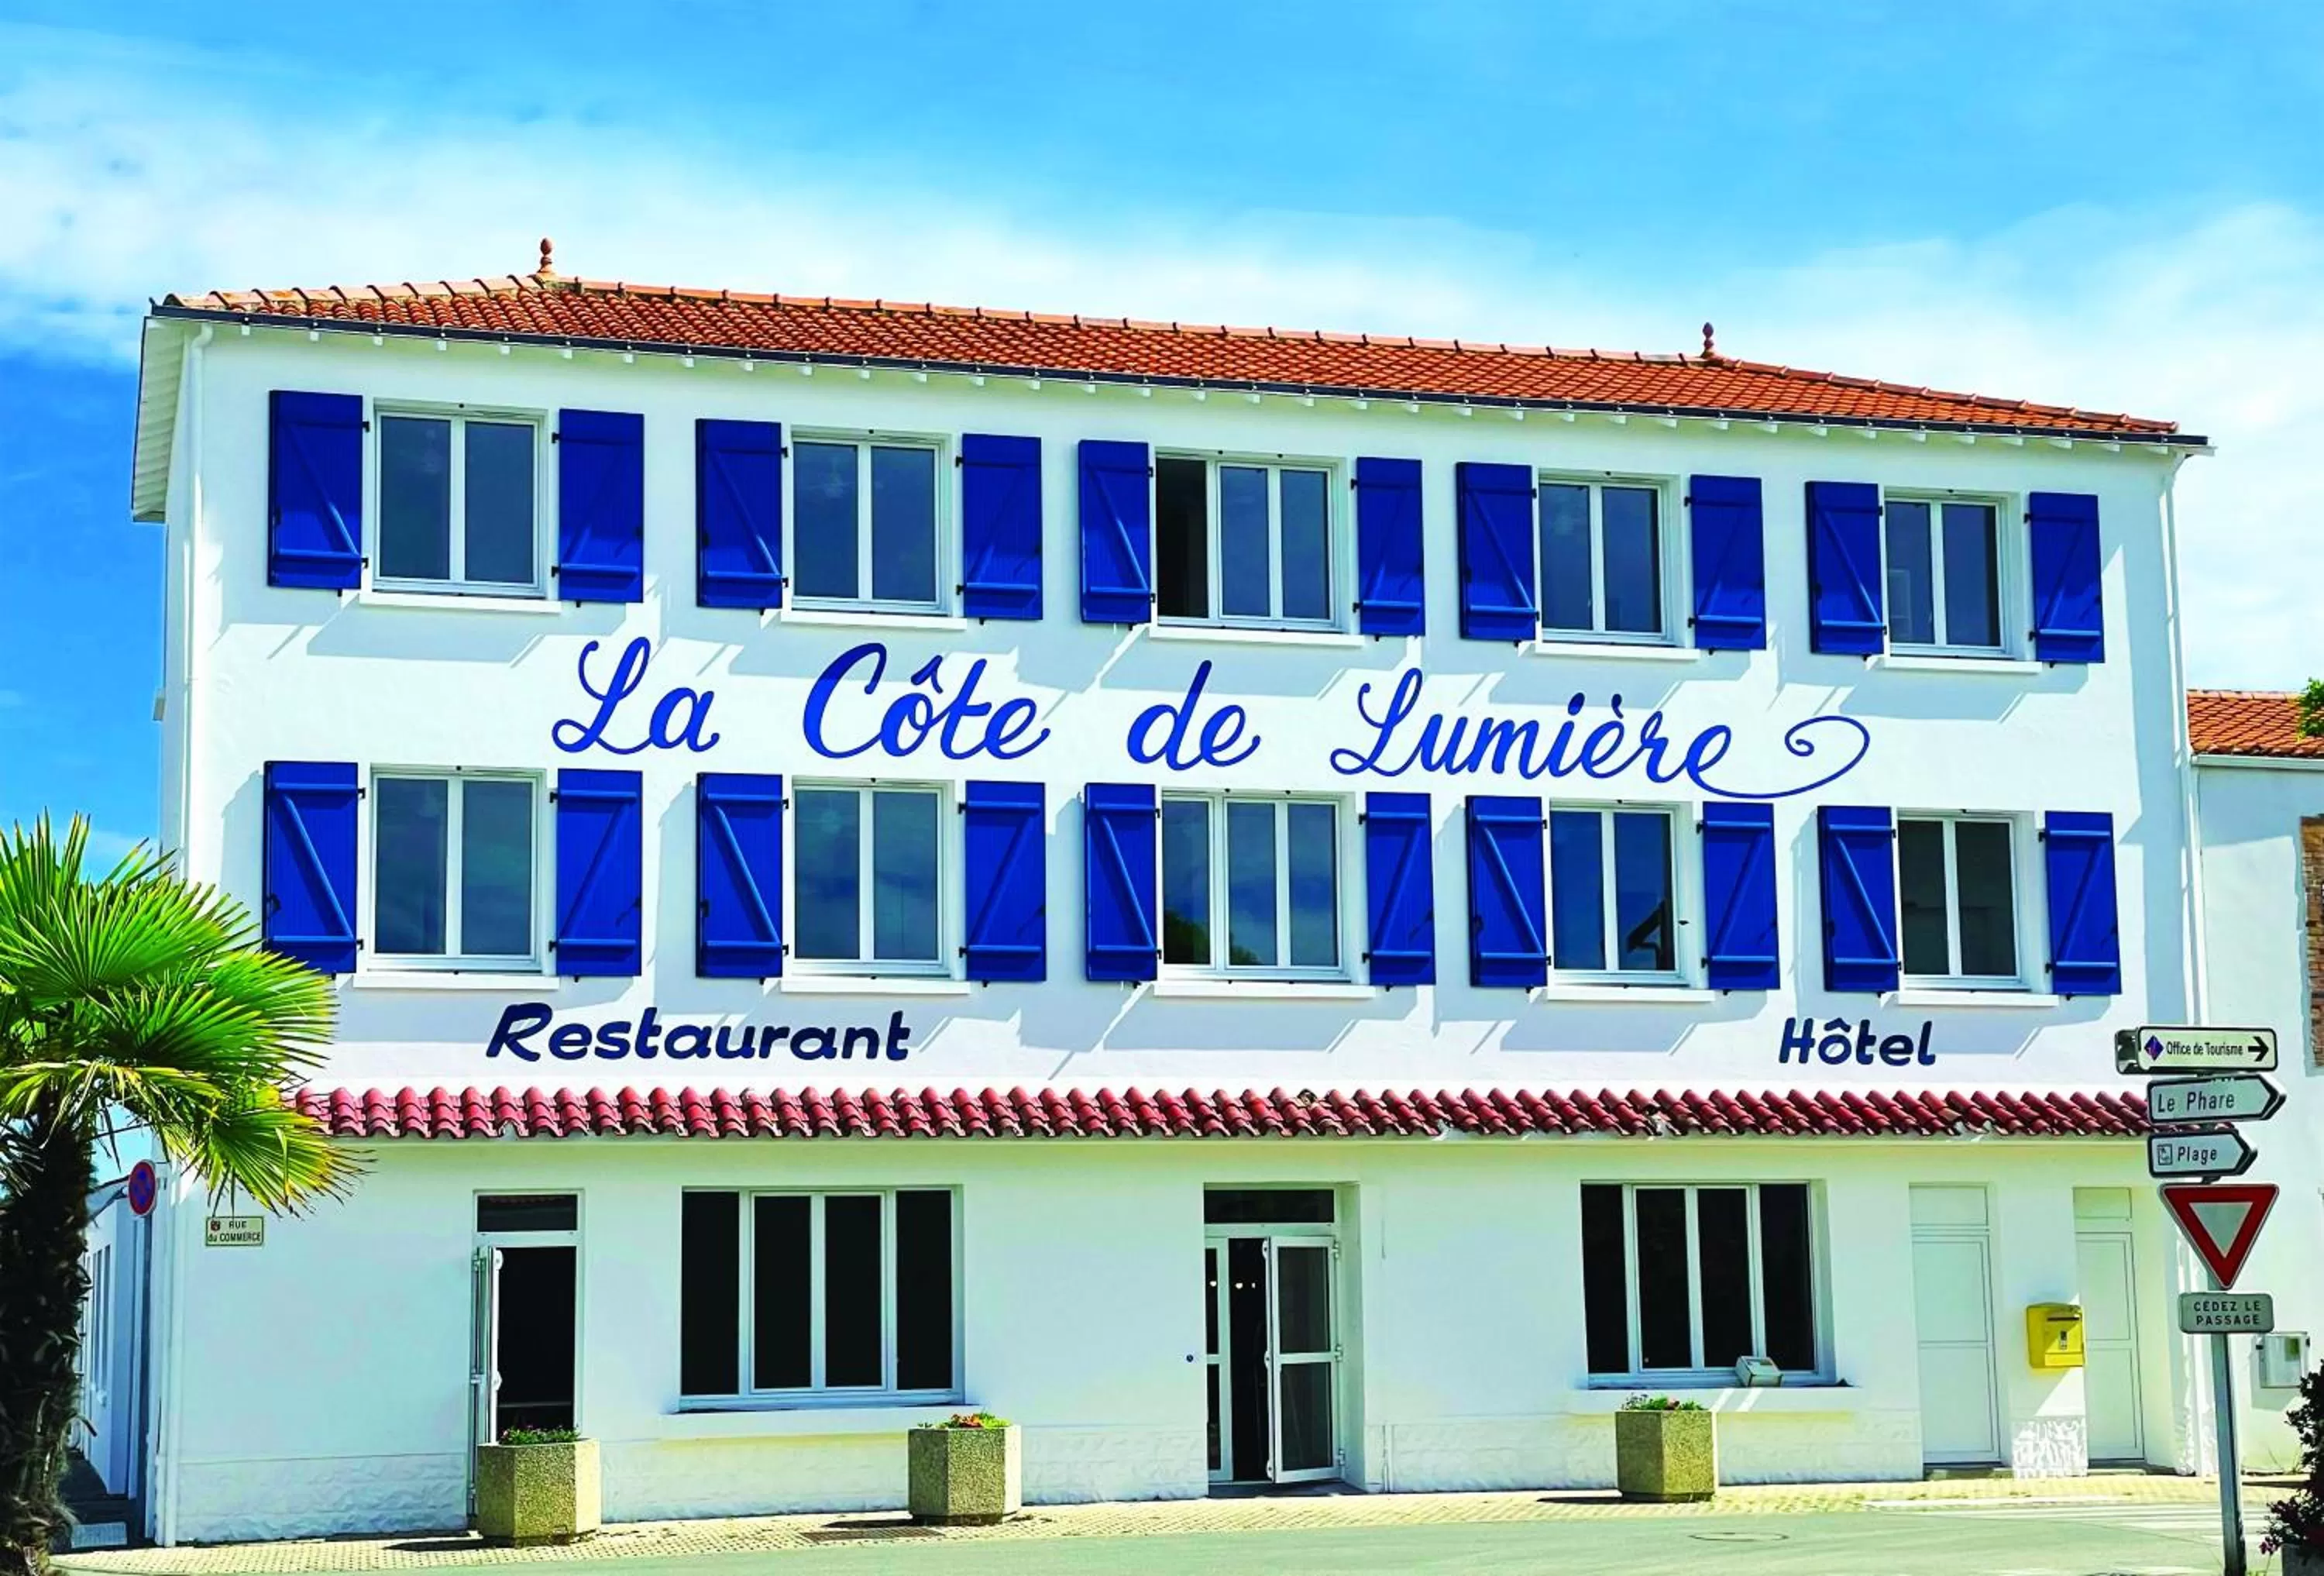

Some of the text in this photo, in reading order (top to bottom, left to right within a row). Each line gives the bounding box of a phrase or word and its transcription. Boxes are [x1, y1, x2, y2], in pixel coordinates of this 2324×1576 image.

[551, 635, 1871, 800] La Côte de Lumière
[485, 1002, 912, 1062] Restaurant
[1778, 1017, 1936, 1067] Hôtel
[2166, 1041, 2243, 1055] Office de Tourisme
[2157, 1090, 2235, 1113] Le Phare
[2177, 1145, 2218, 1165] Plage
[229, 1220, 247, 1229] RUE
[219, 1232, 261, 1242] COMMERCE
[2244, 1299, 2261, 1312] LE
[2195, 1314, 2260, 1326] PASSAGE
